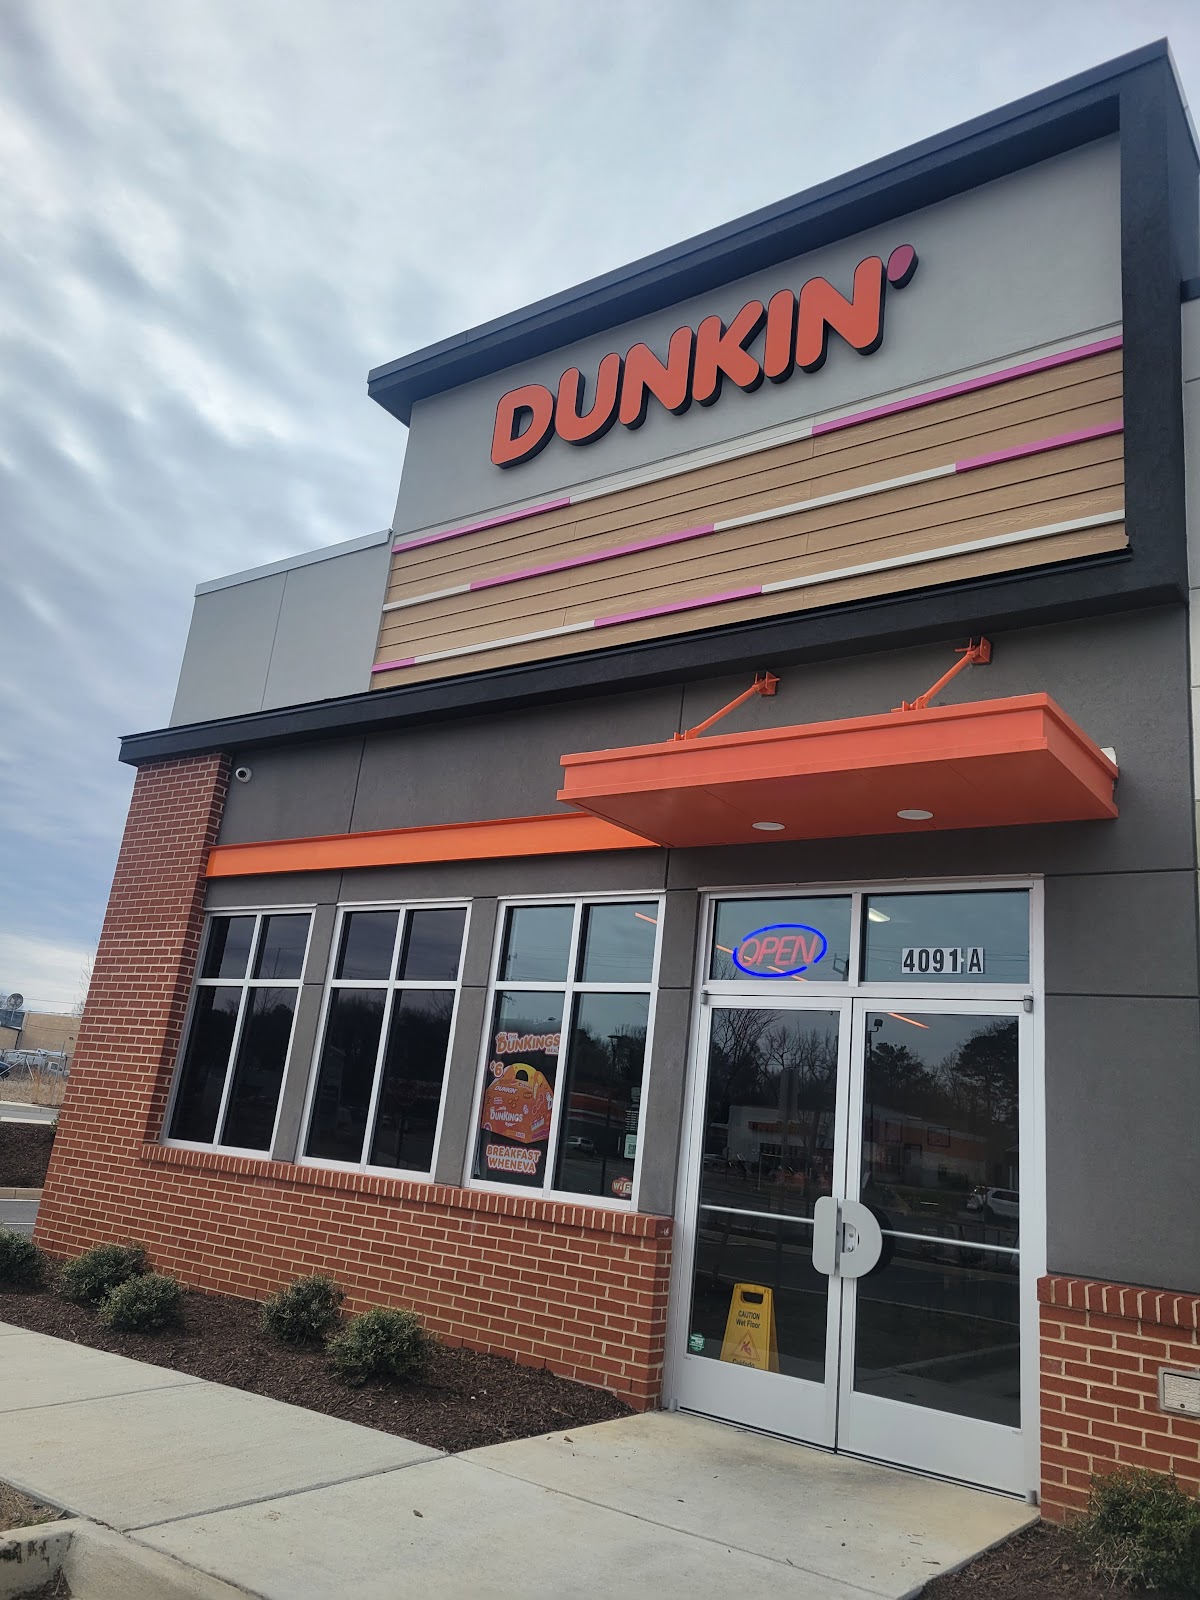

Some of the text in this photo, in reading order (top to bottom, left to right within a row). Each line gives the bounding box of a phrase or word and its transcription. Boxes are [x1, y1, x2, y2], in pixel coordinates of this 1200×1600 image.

[490, 243, 918, 469] DUNKIN'
[738, 934, 818, 968] OPEN
[903, 948, 983, 973] 4091 A
[486, 1145, 541, 1162] BREAKFAST
[488, 1157, 536, 1173] WHENEVA
[736, 1318, 761, 1329] Wet Floor
[738, 1310, 760, 1320] CAUTION
